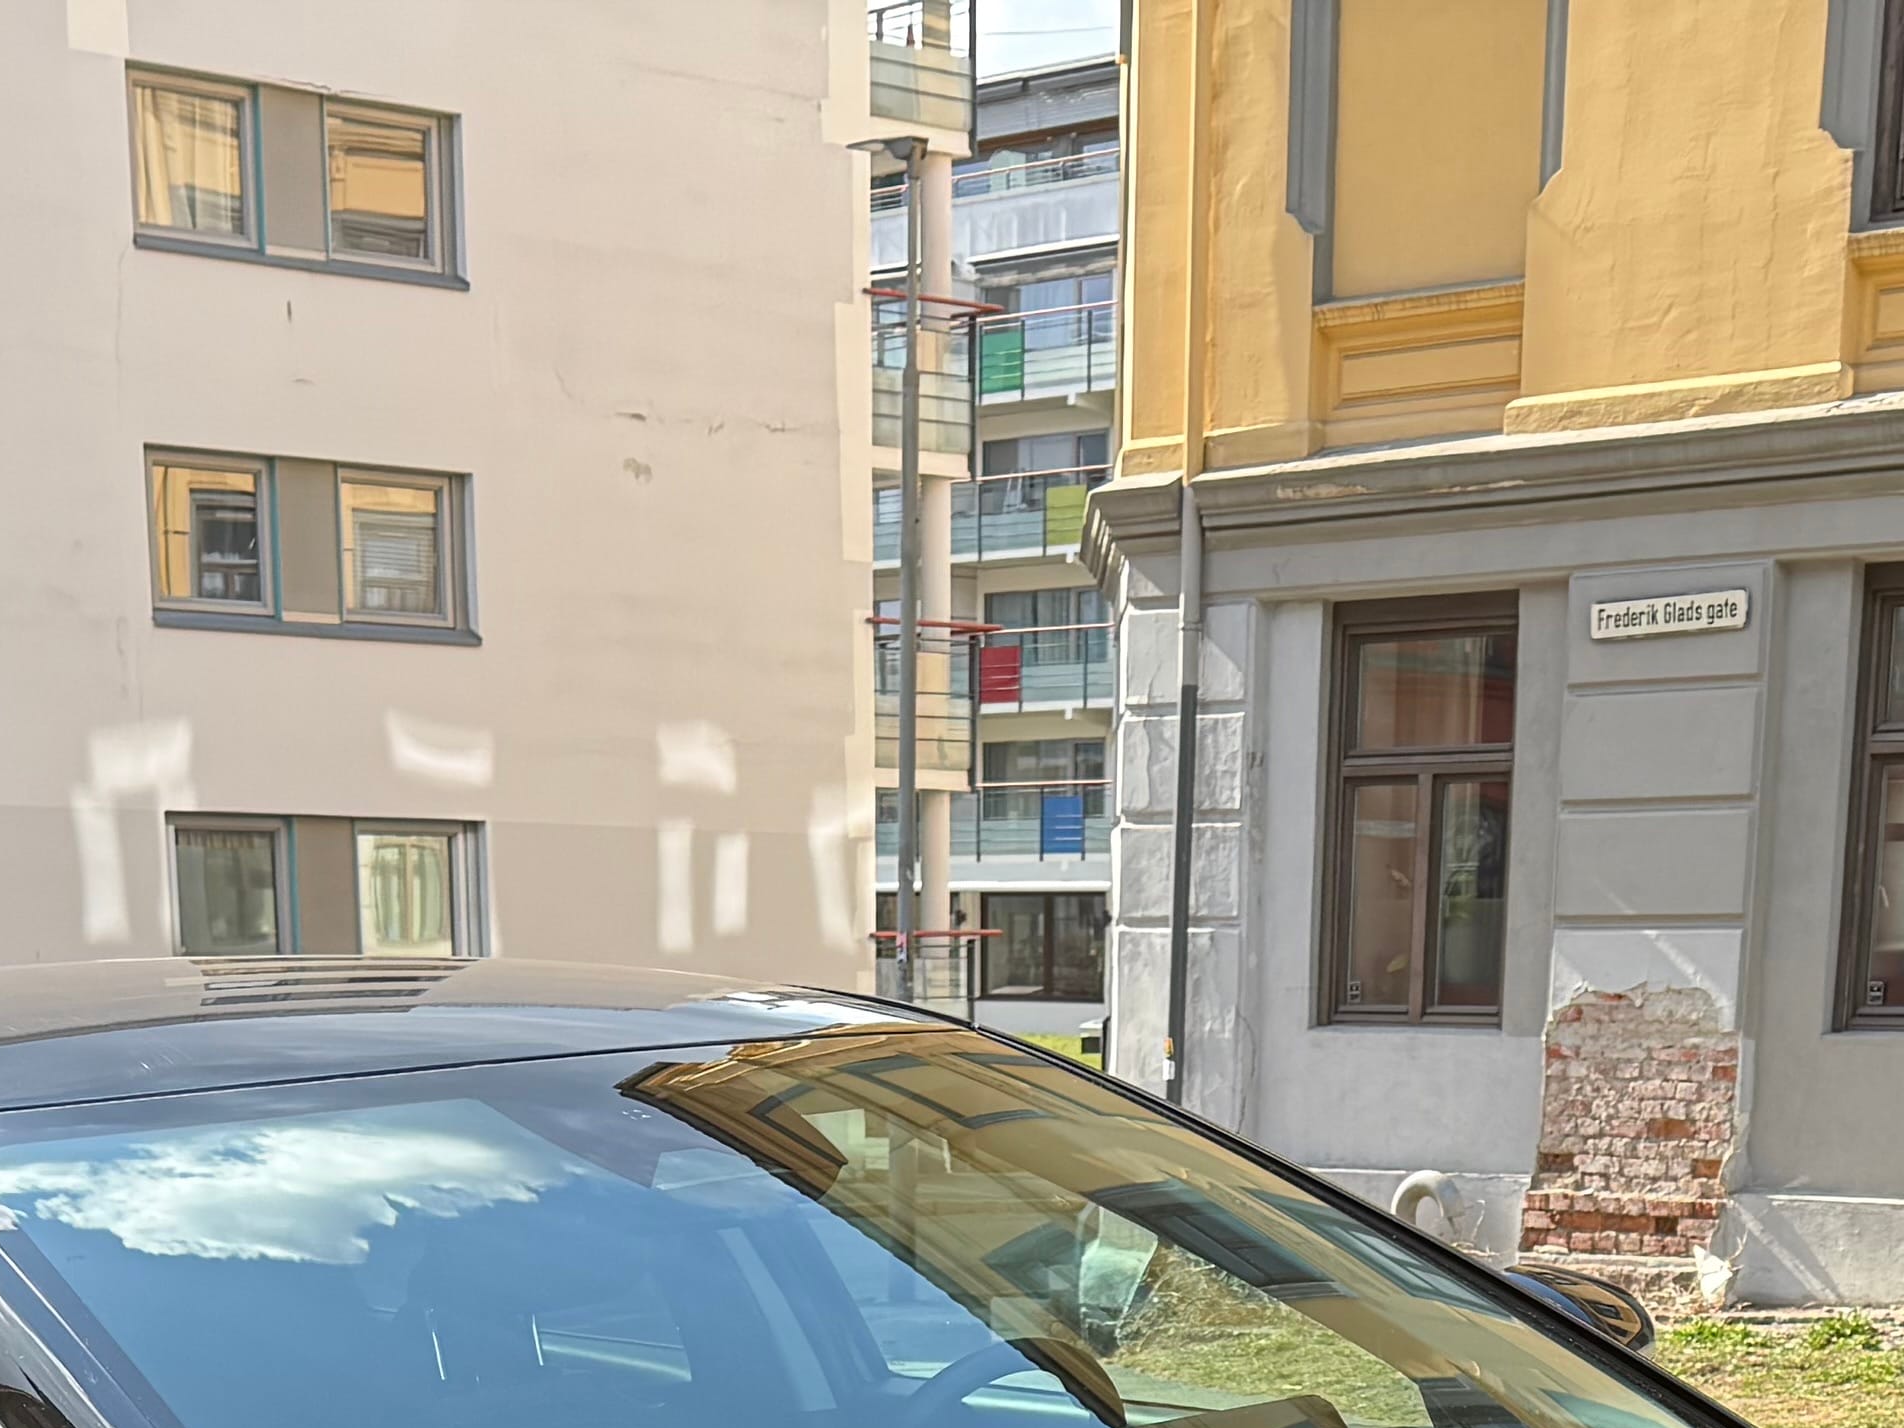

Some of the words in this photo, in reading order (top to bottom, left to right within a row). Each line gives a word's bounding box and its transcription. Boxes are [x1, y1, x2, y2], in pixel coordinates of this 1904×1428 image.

[1597, 604, 1659, 631] Frederik
[1663, 600, 1703, 624] Glads
[1706, 598, 1738, 625] gate
